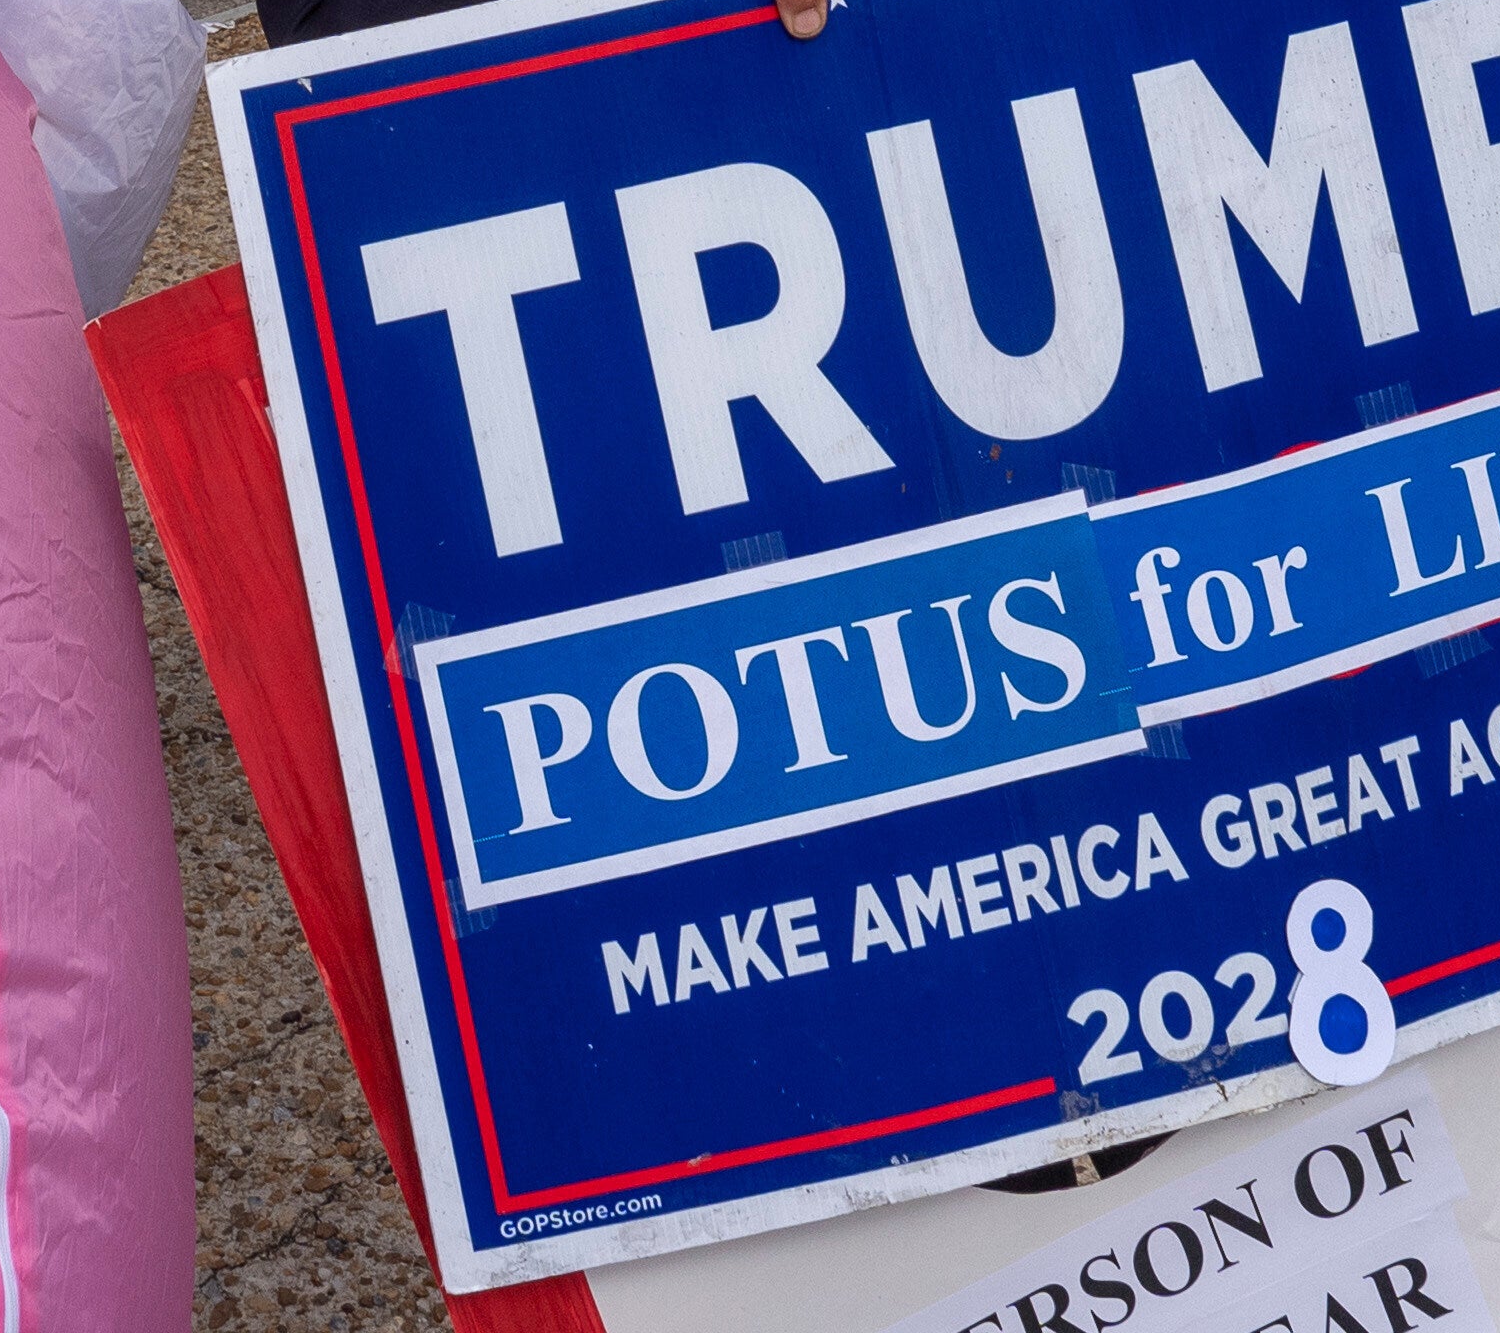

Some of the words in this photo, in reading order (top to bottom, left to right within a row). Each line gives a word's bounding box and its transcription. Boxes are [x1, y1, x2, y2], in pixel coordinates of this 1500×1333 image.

[483, 570, 1087, 836] POTUS
[1131, 545, 1309, 670] for
[601, 896, 830, 1016] MAKE
[851, 812, 1190, 962] AMERICA
[1200, 736, 1421, 869] GREAT
[1066, 879, 1397, 1086] 2028
[500, 1194, 663, 1238] GOPStore.com
[957, 1178, 1275, 1333] RSON
[1294, 1109, 1416, 1219] OF
[1251, 1257, 1455, 1333] AR
